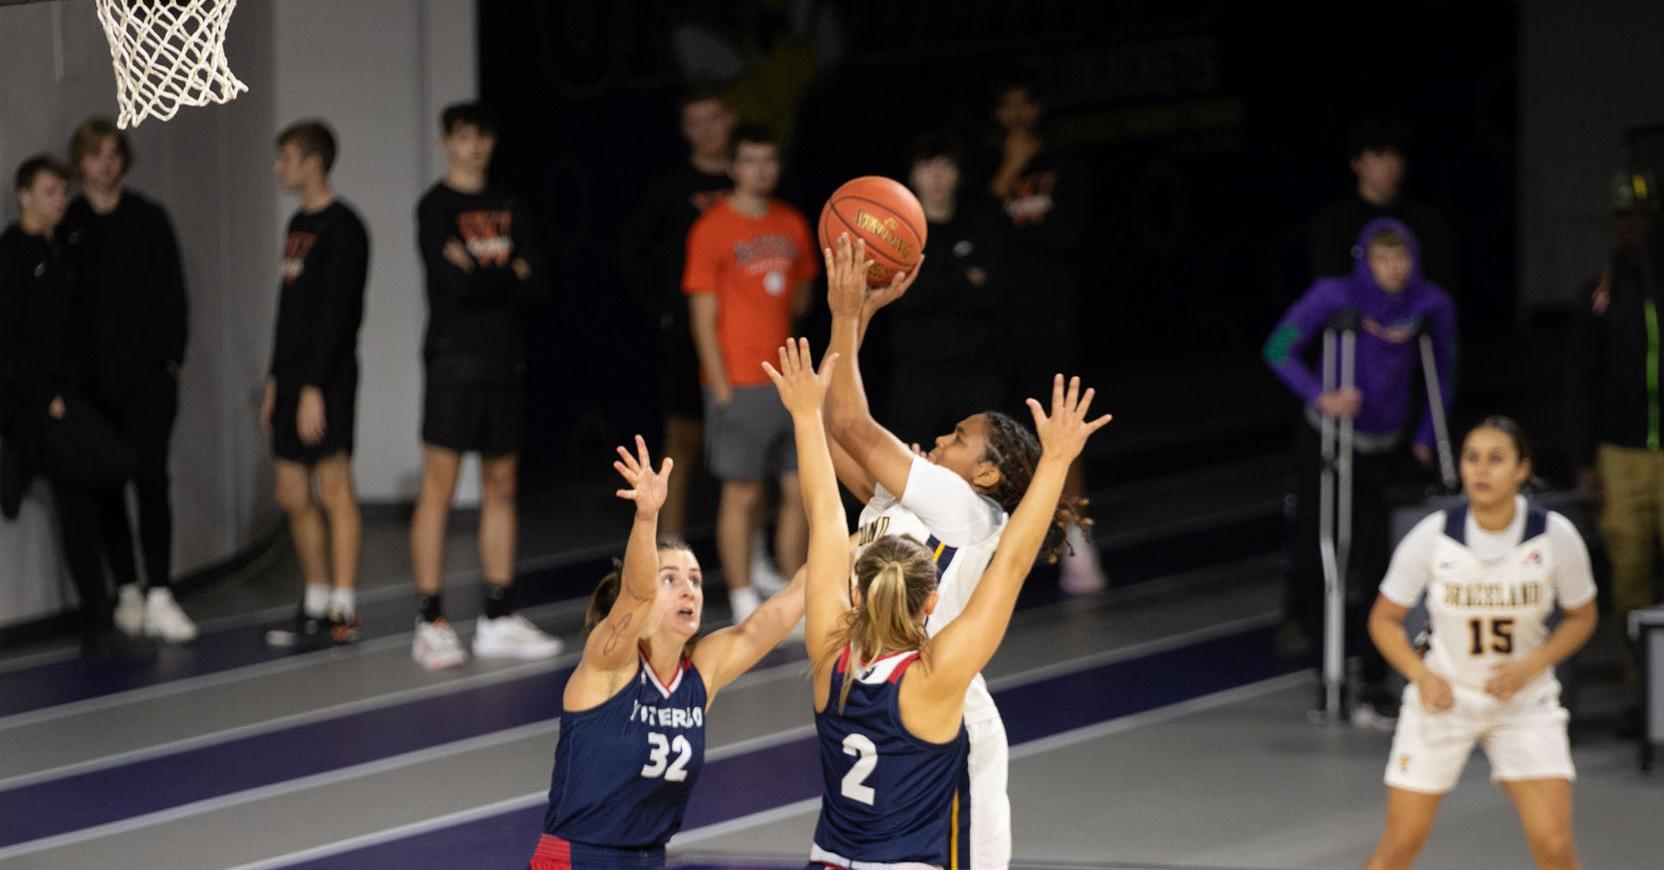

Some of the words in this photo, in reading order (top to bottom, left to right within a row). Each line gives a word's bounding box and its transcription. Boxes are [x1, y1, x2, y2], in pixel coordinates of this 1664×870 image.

[1467, 618, 1516, 655] 15
[640, 732, 692, 782] 32
[841, 733, 878, 806] 2
